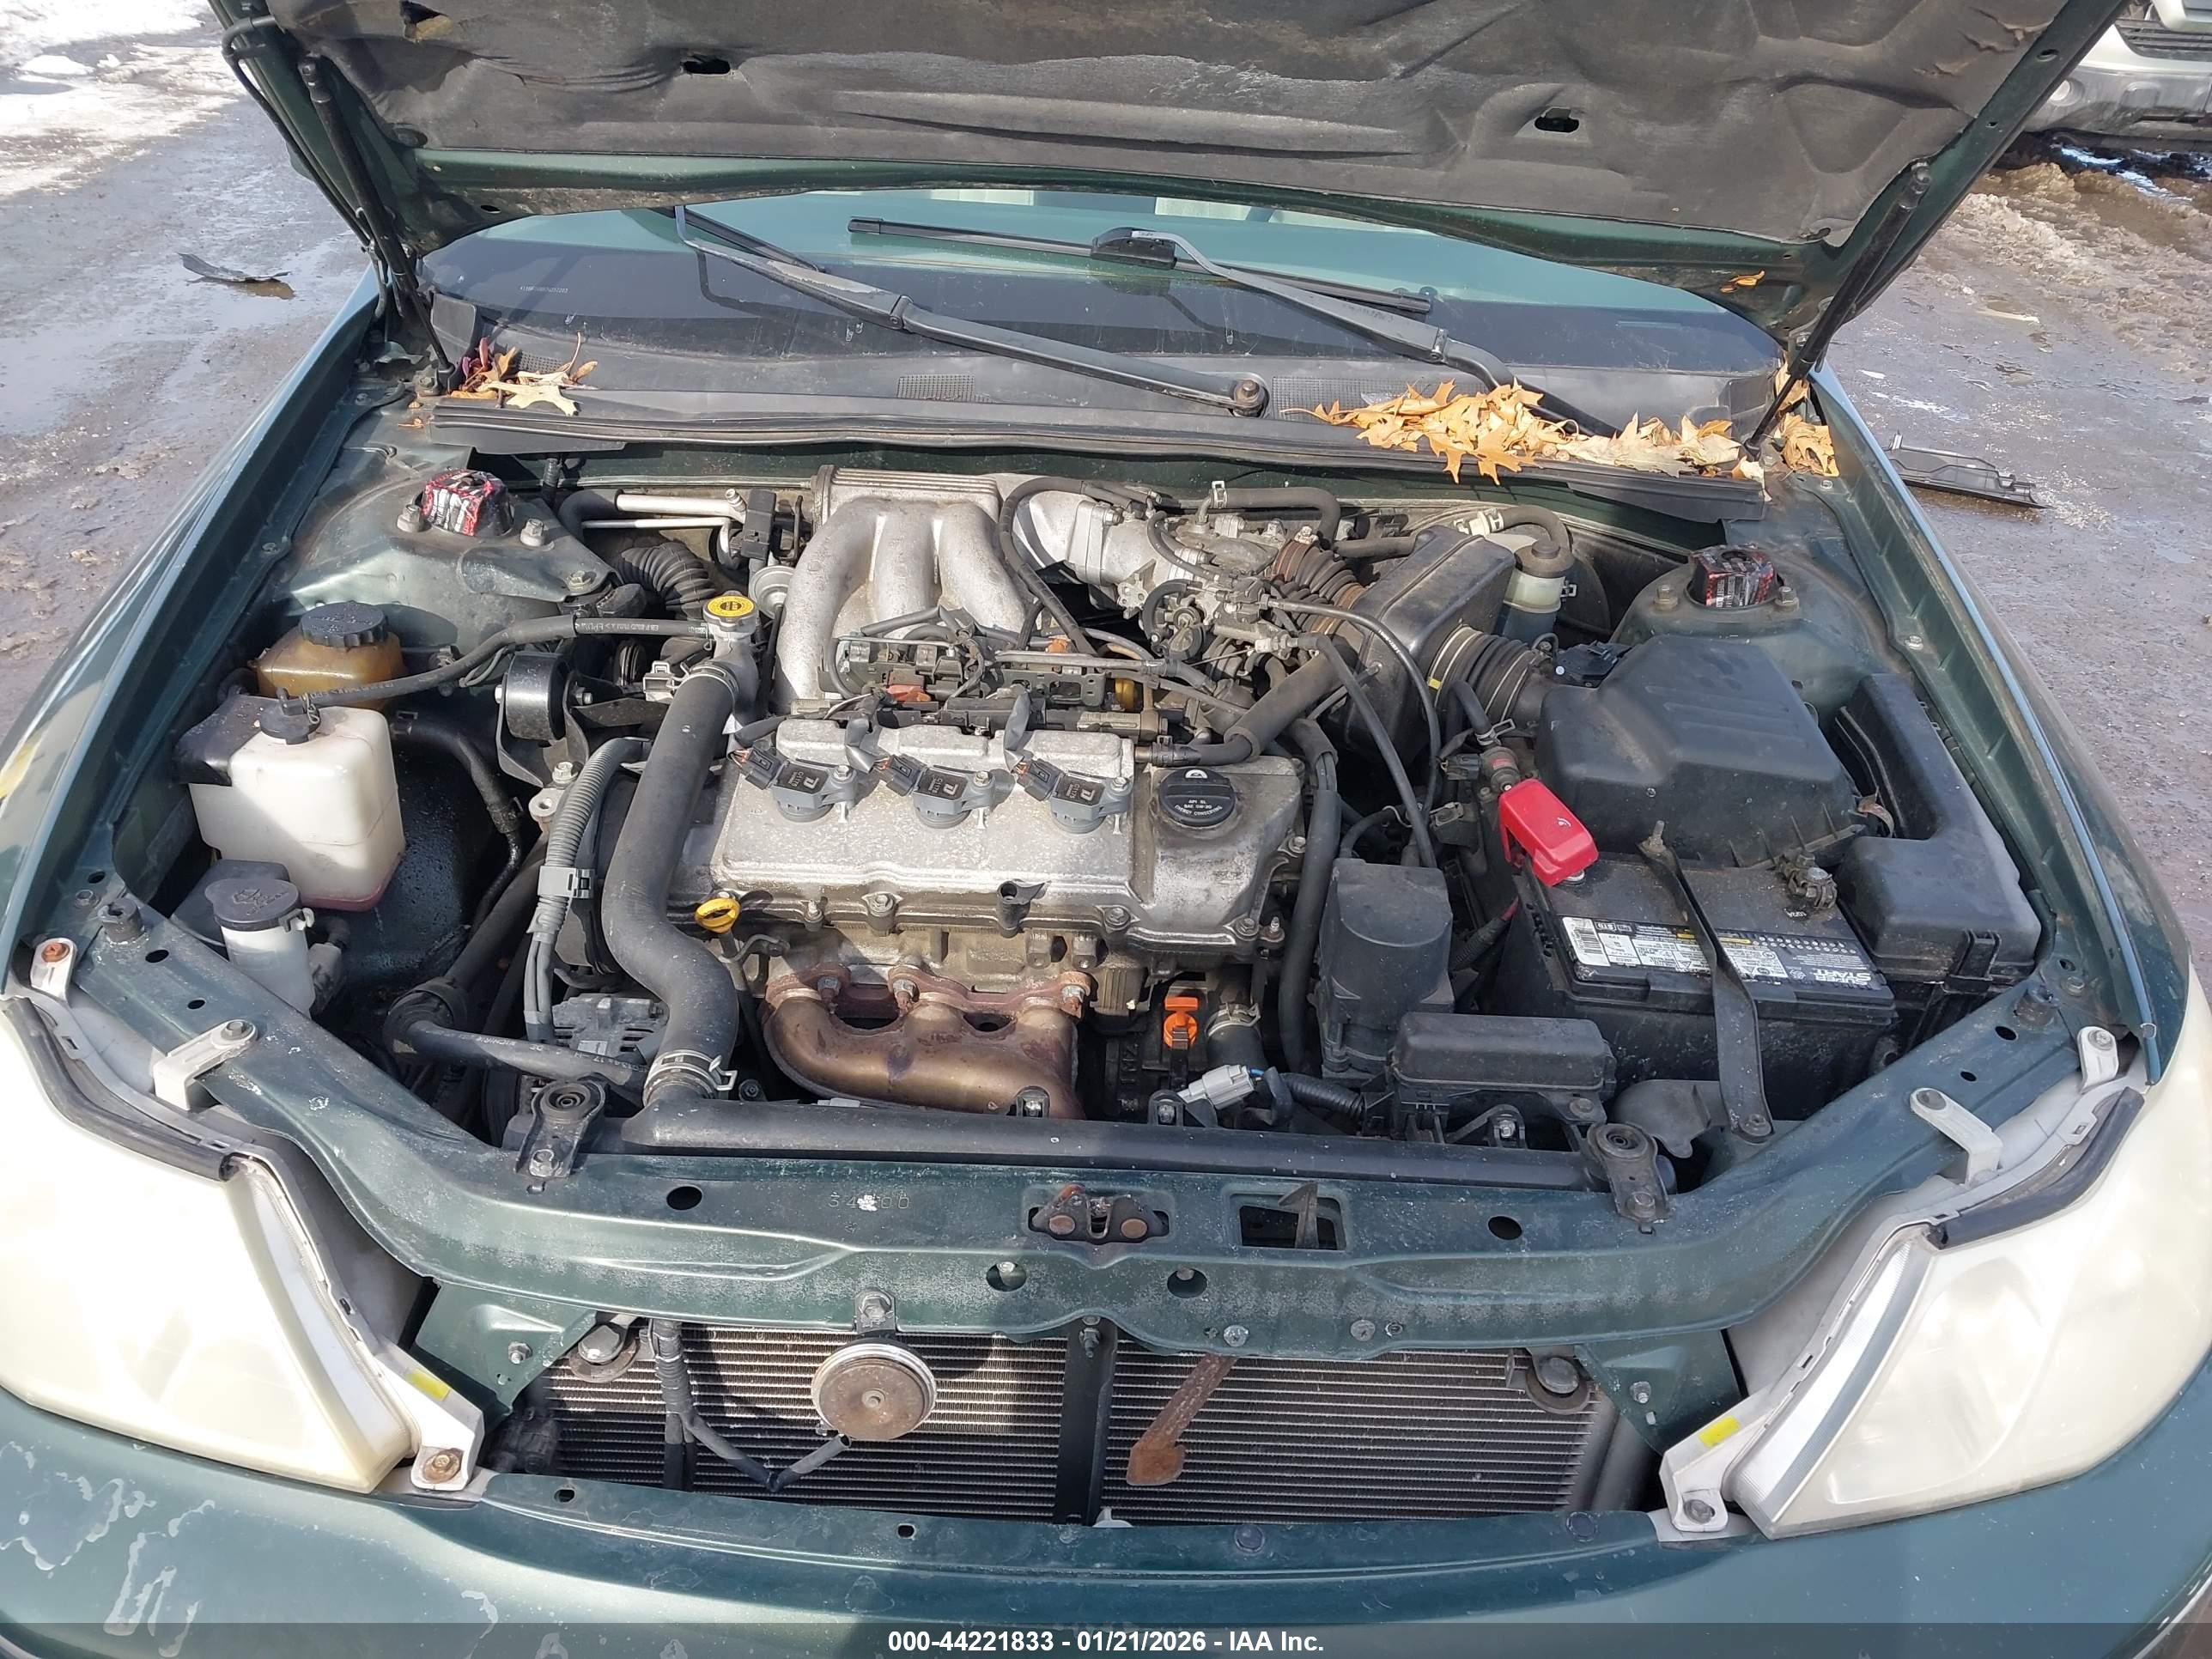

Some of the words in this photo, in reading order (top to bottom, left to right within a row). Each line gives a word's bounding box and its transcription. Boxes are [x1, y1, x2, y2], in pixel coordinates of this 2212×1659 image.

[1174, 804, 1193, 814] ENERGY
[1194, 805, 1223, 816] CONSERVING
[1812, 968, 1872, 981] START
[1814, 975, 1869, 986] SUPER
